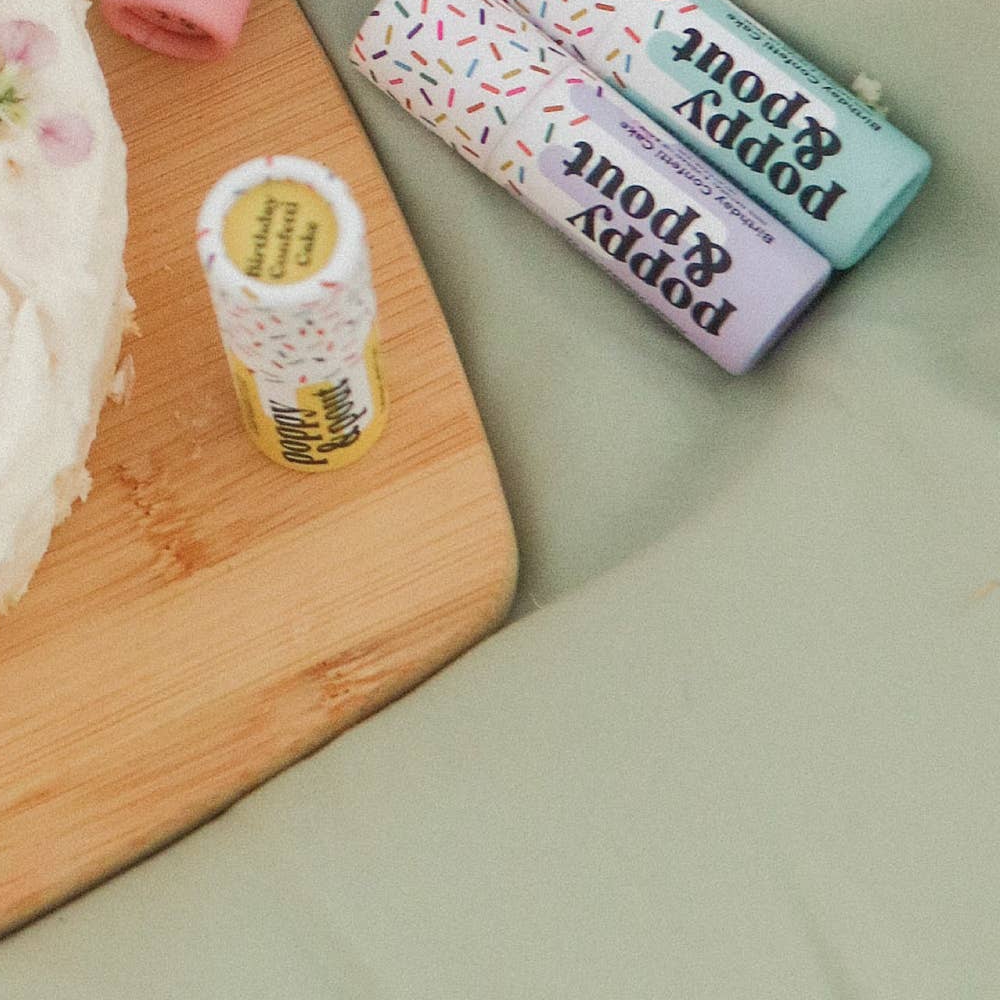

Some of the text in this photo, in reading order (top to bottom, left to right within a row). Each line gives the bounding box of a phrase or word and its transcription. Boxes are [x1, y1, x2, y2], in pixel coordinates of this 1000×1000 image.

[725, 12, 762, 41] Cake
[764, 40, 820, 85] Confetti
[821, 84, 883, 132] Birthday
[619, 120, 655, 151] Cake
[672, 89, 847, 222] poppy
[656, 149, 713, 197] Confetti
[714, 193, 776, 245] Birthday
[566, 204, 738, 336] poppy
[268, 399, 329, 465] poppy
